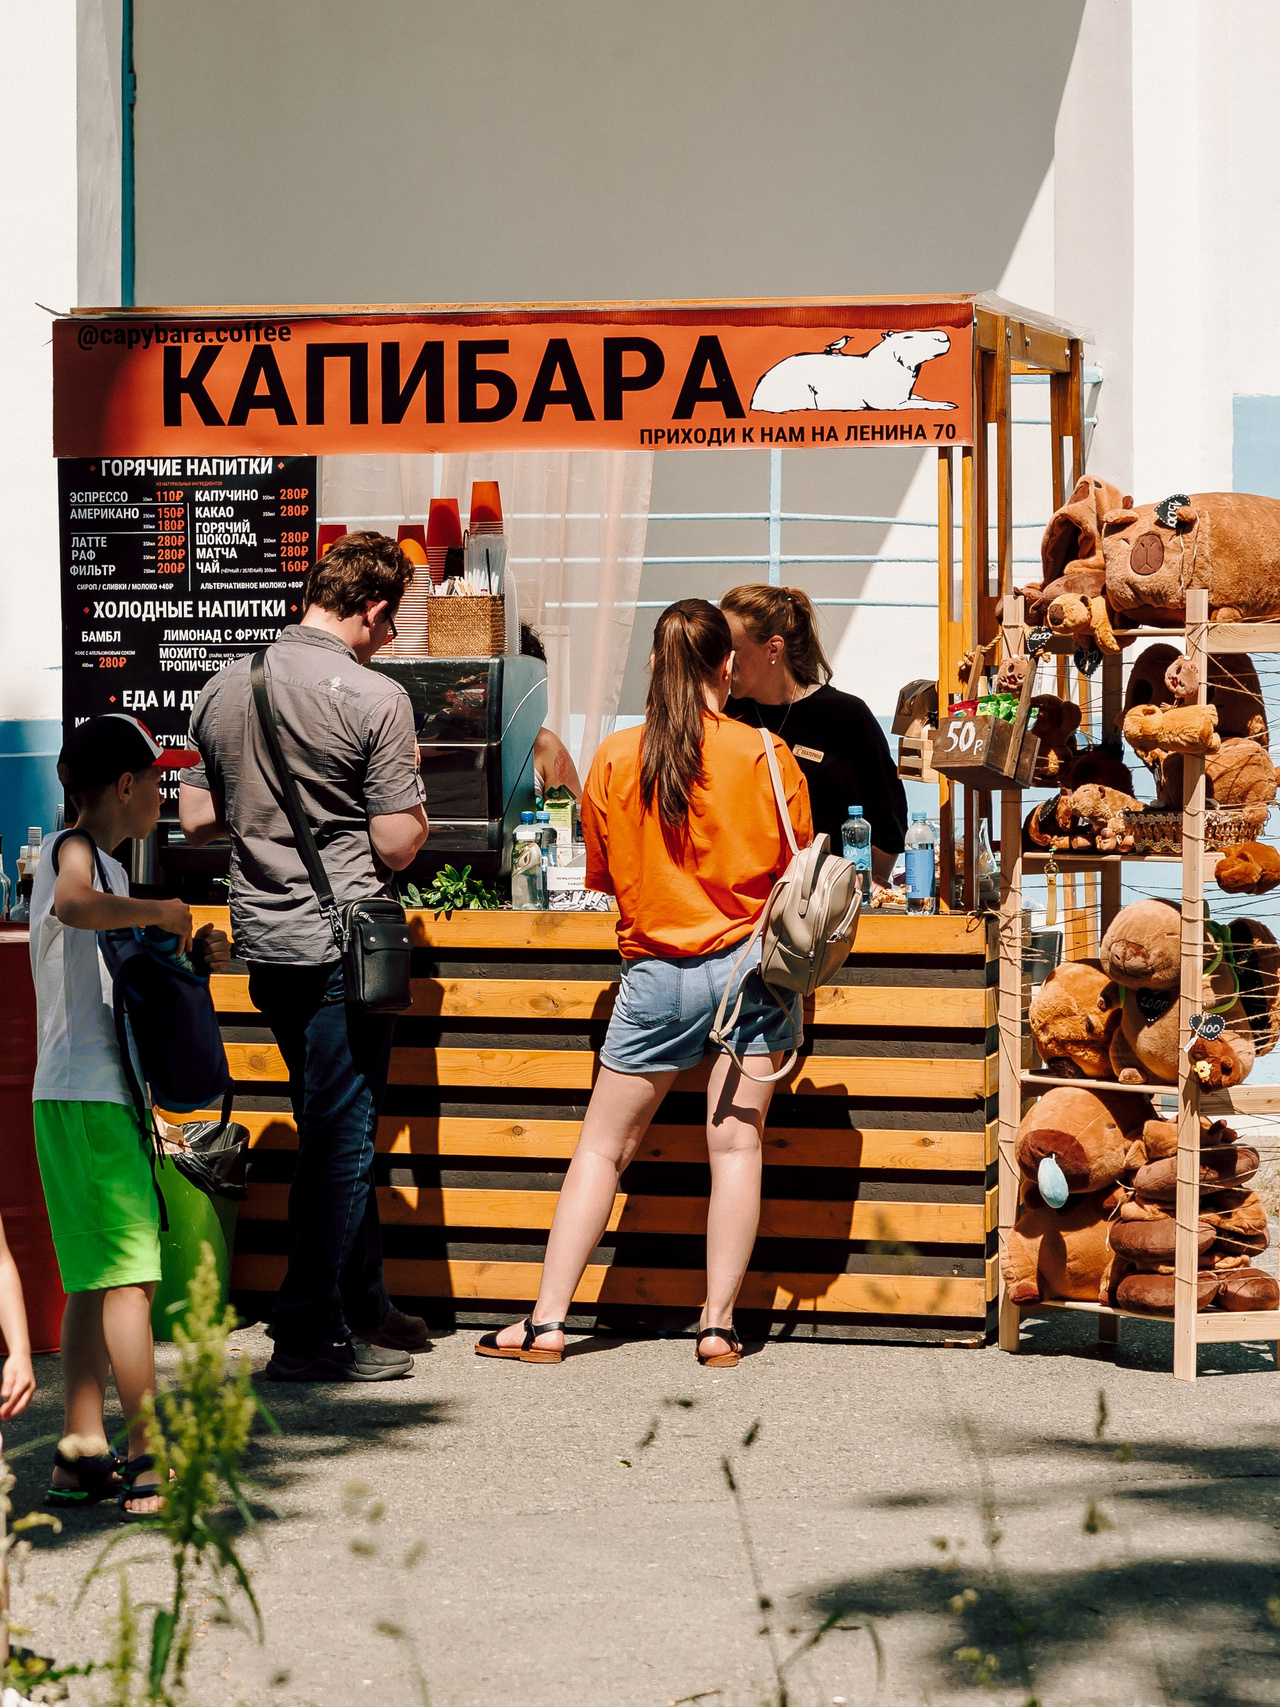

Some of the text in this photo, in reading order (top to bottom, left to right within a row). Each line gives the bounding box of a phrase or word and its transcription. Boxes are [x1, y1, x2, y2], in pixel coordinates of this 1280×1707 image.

[77, 321, 292, 351] @capybara.coffee
[163, 335, 747, 427] КАПИБАРА
[639, 423, 957, 447] ПРИХОДИ К НАМ НА ЛЕНИНА 70
[101, 457, 273, 477] ГОРЯЧИЕ НАПИТКИ
[69, 491, 129, 503] ЭСПРЕССО
[156, 490, 184, 502] 110₽
[195, 489, 259, 502] КАПУЧИНО
[280, 488, 309, 500] 280₽
[69, 507, 140, 519] АМЕРИКАНО
[157, 507, 185, 519] 150₽
[195, 506, 235, 518] КАКАО
[280, 505, 309, 517] 280₽
[157, 520, 185, 531] 180₽
[195, 519, 251, 534] ГОРЯЧИЙ
[71, 536, 108, 548] ЛАТТЕ
[157, 535, 185, 547] 280₽
[195, 533, 258, 547] ШОКОЛАД
[280, 532, 309, 544] 280₽
[71, 549, 96, 561] РАФ
[157, 549, 186, 560] 280₽
[196, 547, 238, 559] МАТЧА
[280, 546, 309, 557] 280₽
[69, 564, 116, 576] ФИЛЬТР
[157, 562, 186, 574] 200₽
[195, 559, 220, 573] ЧАЙ
[280, 561, 309, 573] 160₽
[200, 582, 259, 590] АЛЬТЕРНАТИВНОЕ
[260, 581, 287, 589] МОЛОКО
[93, 599, 286, 621] ХОЛОДНЫЕ НАПИТКИ
[81, 630, 121, 642] БАМБЛ
[163, 629, 222, 643] ЛИМОНАД
[224, 629, 233, 641] С
[159, 647, 207, 659] МОХИТО
[98, 656, 127, 669] 280₽
[122, 690, 159, 711] ЕДА
[163, 690, 176, 707] И
